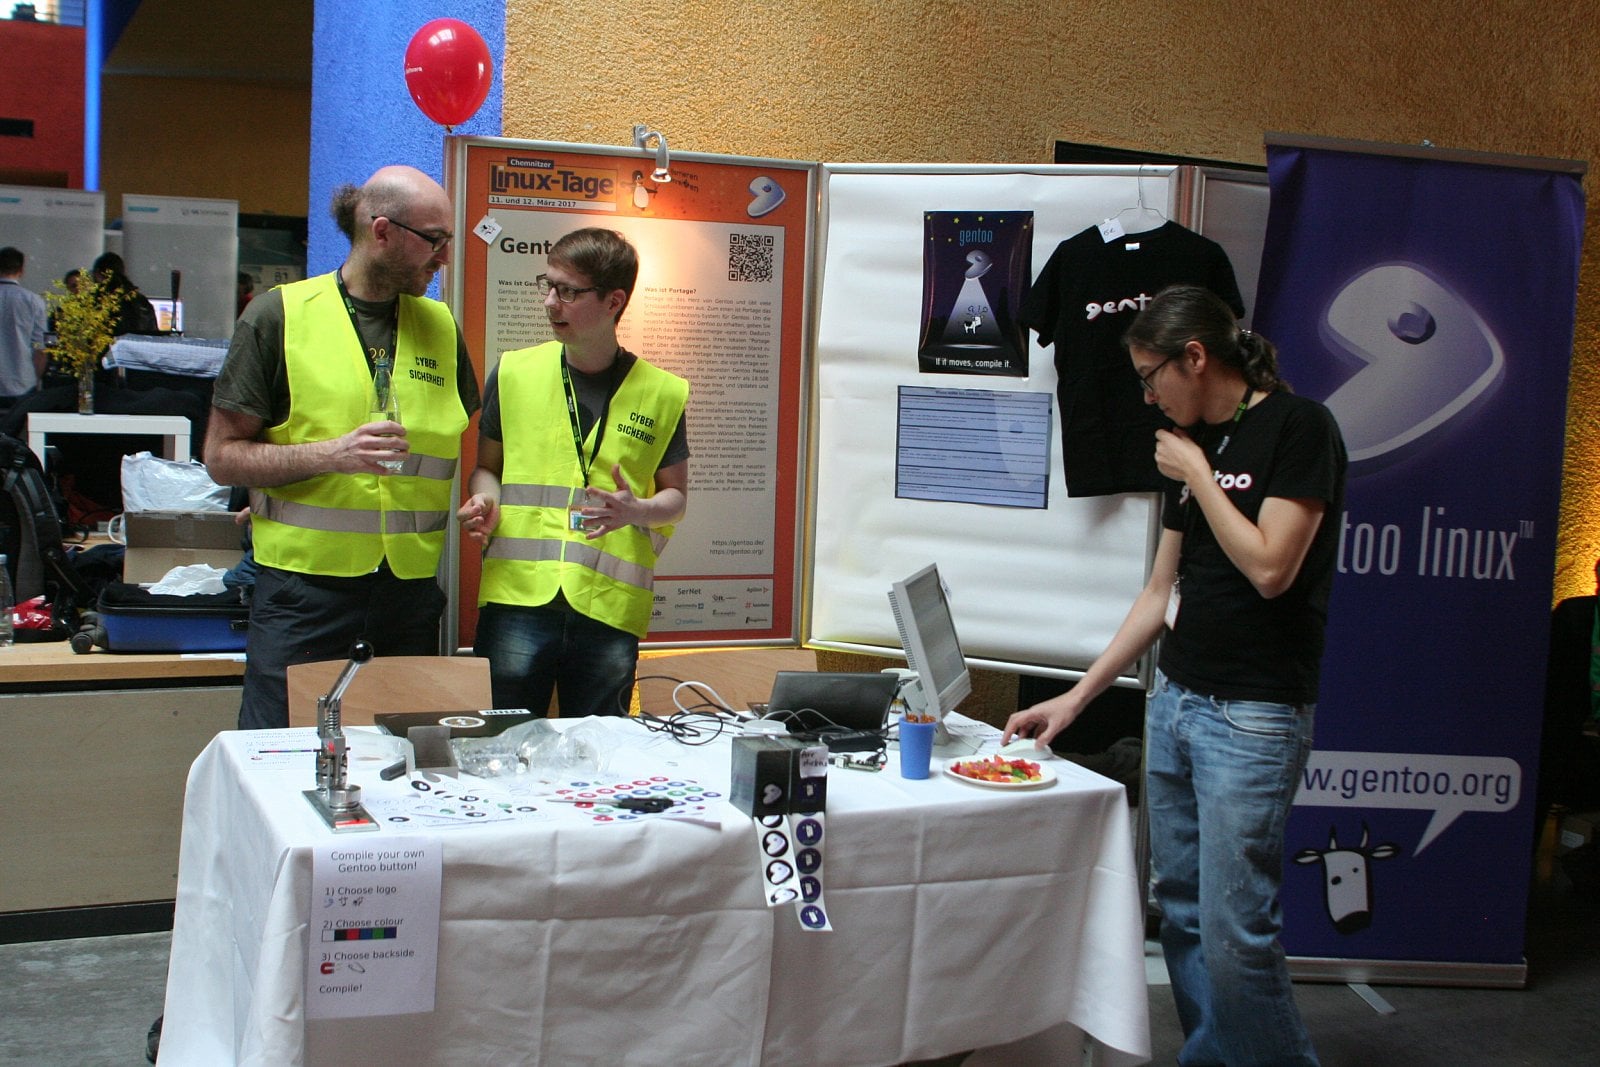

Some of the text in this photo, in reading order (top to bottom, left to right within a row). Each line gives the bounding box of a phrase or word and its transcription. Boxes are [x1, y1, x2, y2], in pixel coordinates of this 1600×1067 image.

[510, 160, 552, 168] Chemnitzer
[491, 165, 613, 198] Linux-Tage
[960, 228, 992, 246] gentoo
[500, 237, 552, 255] Gent
[1086, 293, 1152, 320] gent
[949, 359, 973, 368] moves,
[975, 359, 1002, 368] compile
[409, 370, 444, 387] SICHERHEIT
[1179, 470, 1252, 504] gtoo
[1336, 510, 1401, 576] too
[1418, 506, 1518, 580] linux
[1303, 766, 1512, 804] w.gentoo.org
[331, 850, 424, 862] Compile your own
[338, 862, 417, 872] Gentoo button!
[325, 885, 397, 896] 1) Choose logo
[323, 918, 404, 929] 2) Choose colour
[321, 949, 415, 962] 3) Choose backside
[319, 984, 362, 995] Compile!
